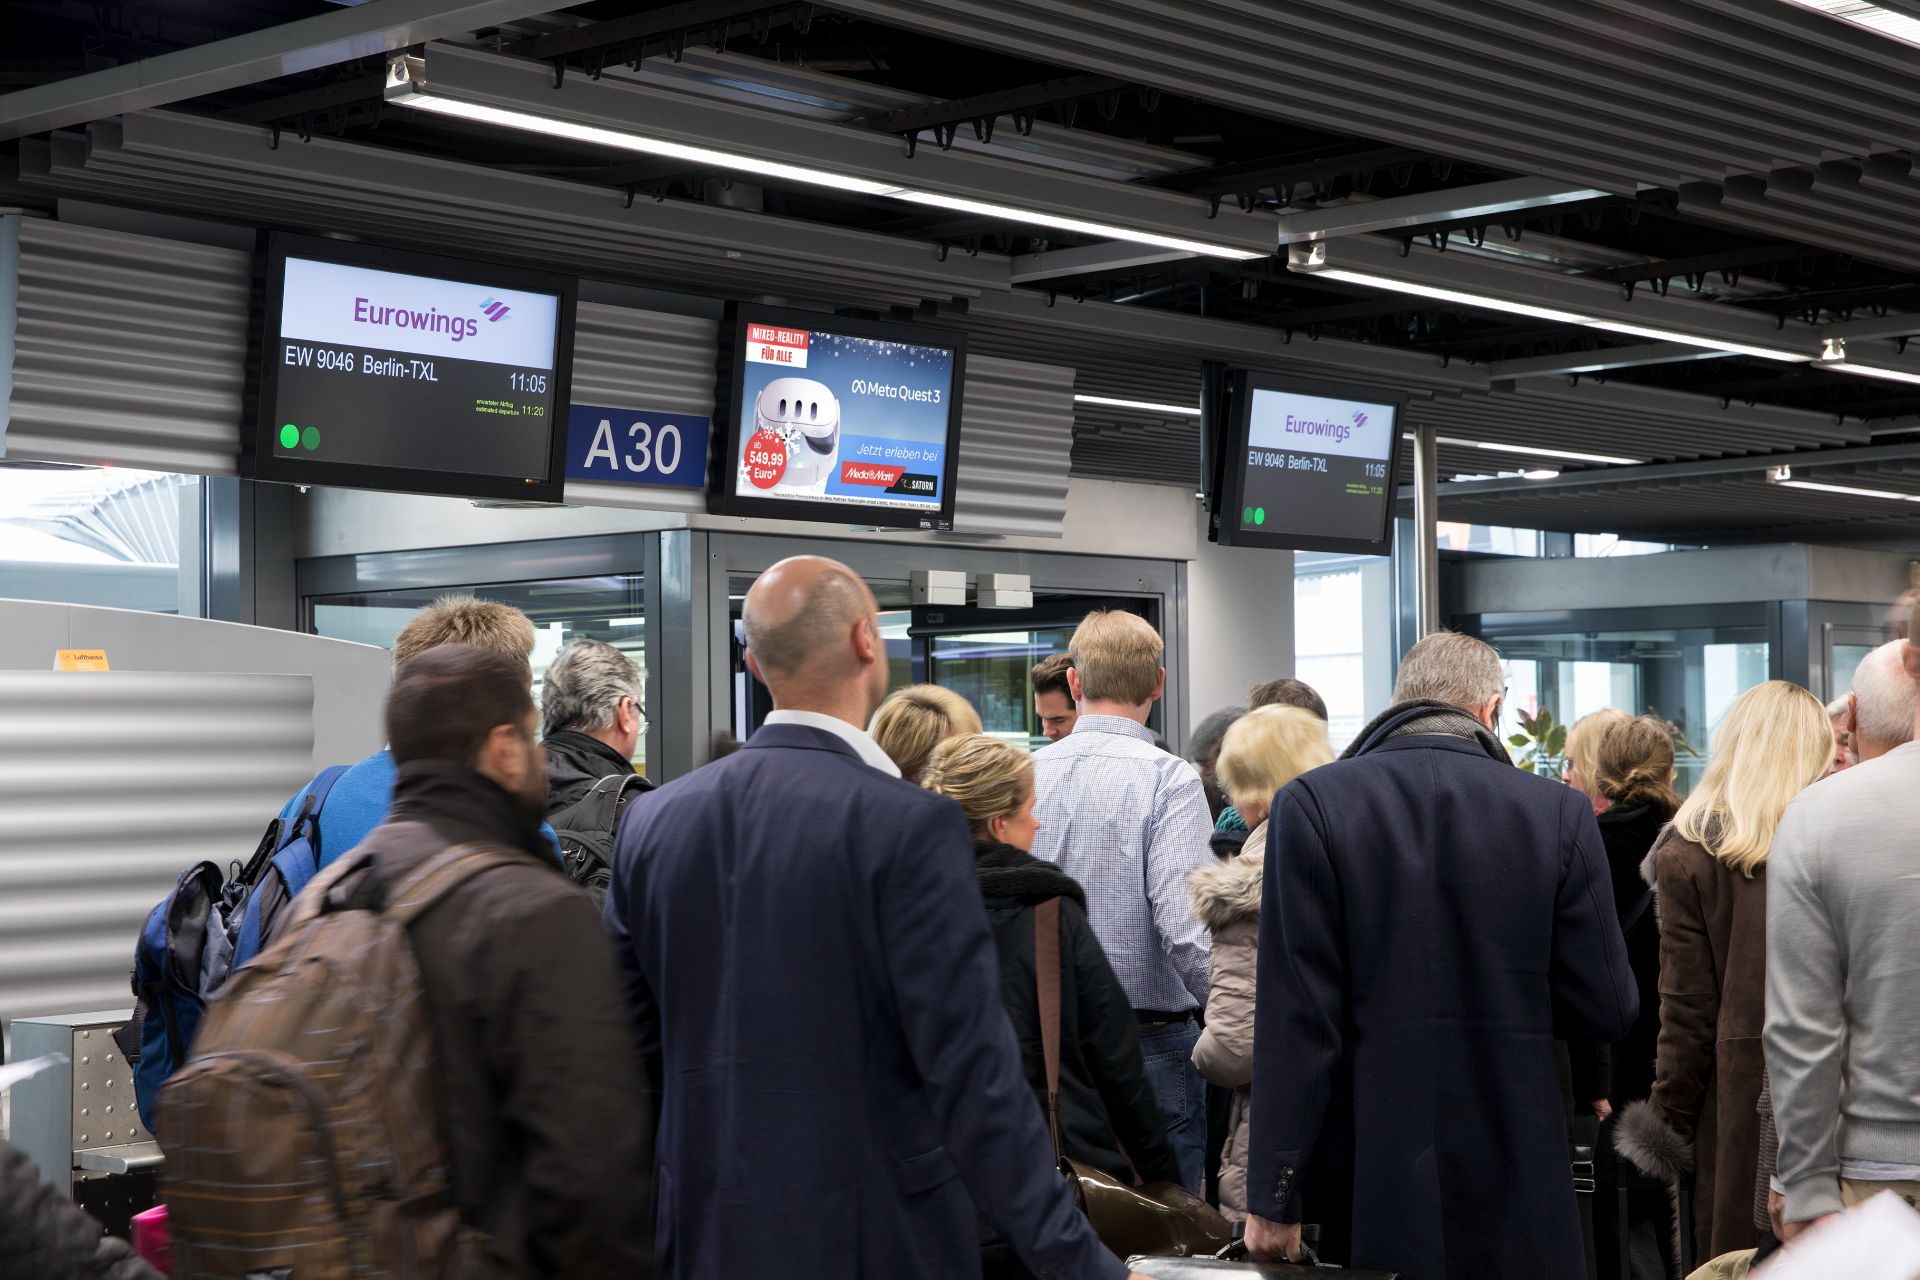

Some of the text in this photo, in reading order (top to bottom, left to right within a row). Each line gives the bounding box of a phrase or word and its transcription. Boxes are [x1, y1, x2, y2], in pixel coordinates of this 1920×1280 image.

[353, 297, 478, 342] Eurowings
[752, 327, 804, 345] MIXED-REALITY
[761, 346, 792, 362] FÜR ALLE
[285, 345, 438, 382] EW 9046 Berlin-TXL
[510, 372, 546, 393] 11:05
[868, 381, 940, 403] Meta Quest 3
[522, 405, 544, 416] 11:20
[1285, 414, 1350, 443] Eurowings
[753, 441, 761, 449] ab
[857, 443, 938, 461] Jetzt erleben bei
[750, 450, 783, 467] 549,99
[1248, 451, 1328, 473] EW 9046 Berlin-TXL
[1365, 463, 1385, 478] 11:05
[911, 480, 934, 491] SATURN
